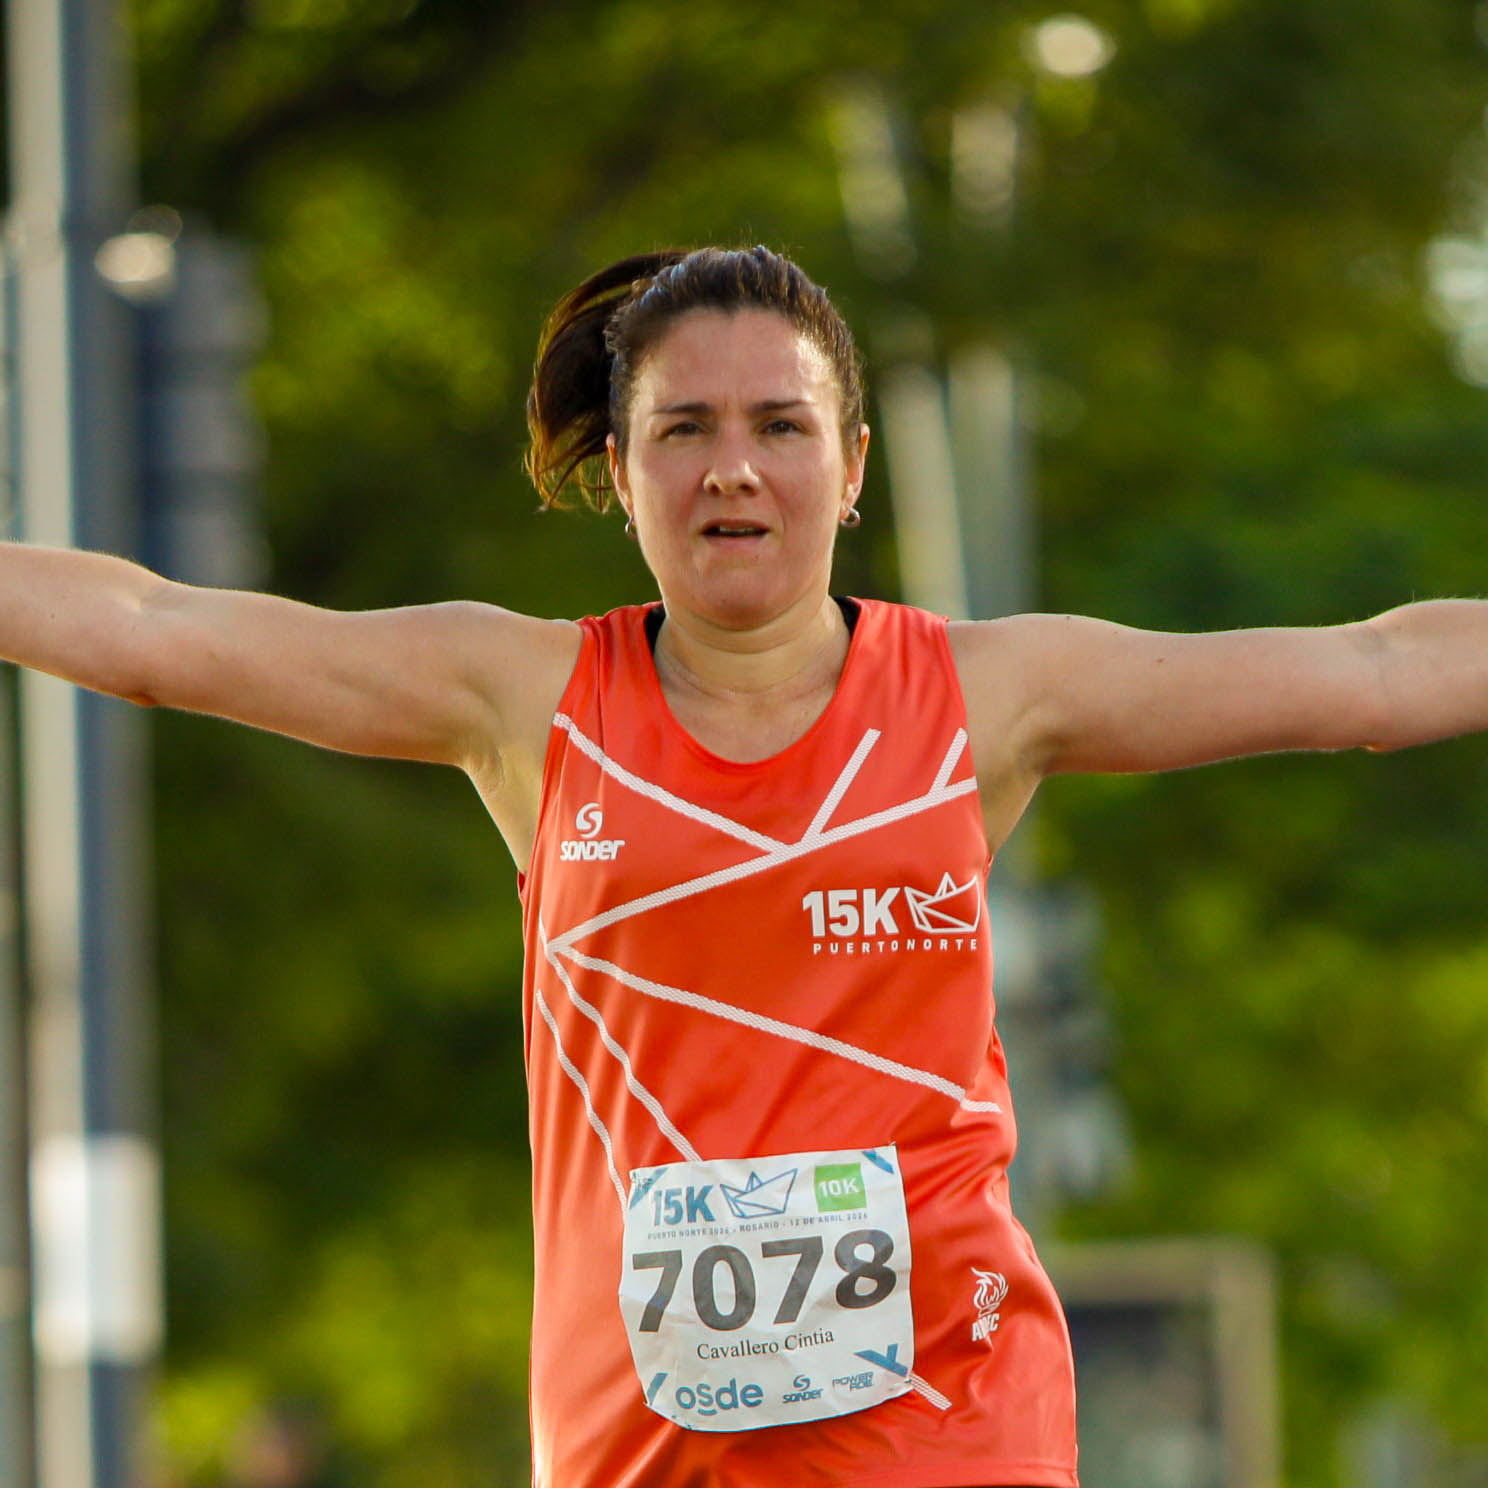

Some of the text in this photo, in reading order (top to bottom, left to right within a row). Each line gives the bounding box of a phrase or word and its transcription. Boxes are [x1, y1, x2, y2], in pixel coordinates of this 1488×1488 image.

[802, 887, 900, 937] 15K
[818, 1177, 860, 1198] 10K
[652, 1185, 716, 1226] 15K
[679, 1227, 706, 1237] NORTE
[739, 1222, 779, 1232] ROSARIO
[803, 1217, 815, 1225] DE
[818, 1215, 842, 1223] ABRIL
[632, 1229, 897, 1333] 7078
[697, 1327, 835, 1360] Cavallero Cintia
[675, 1378, 763, 1412] osde
